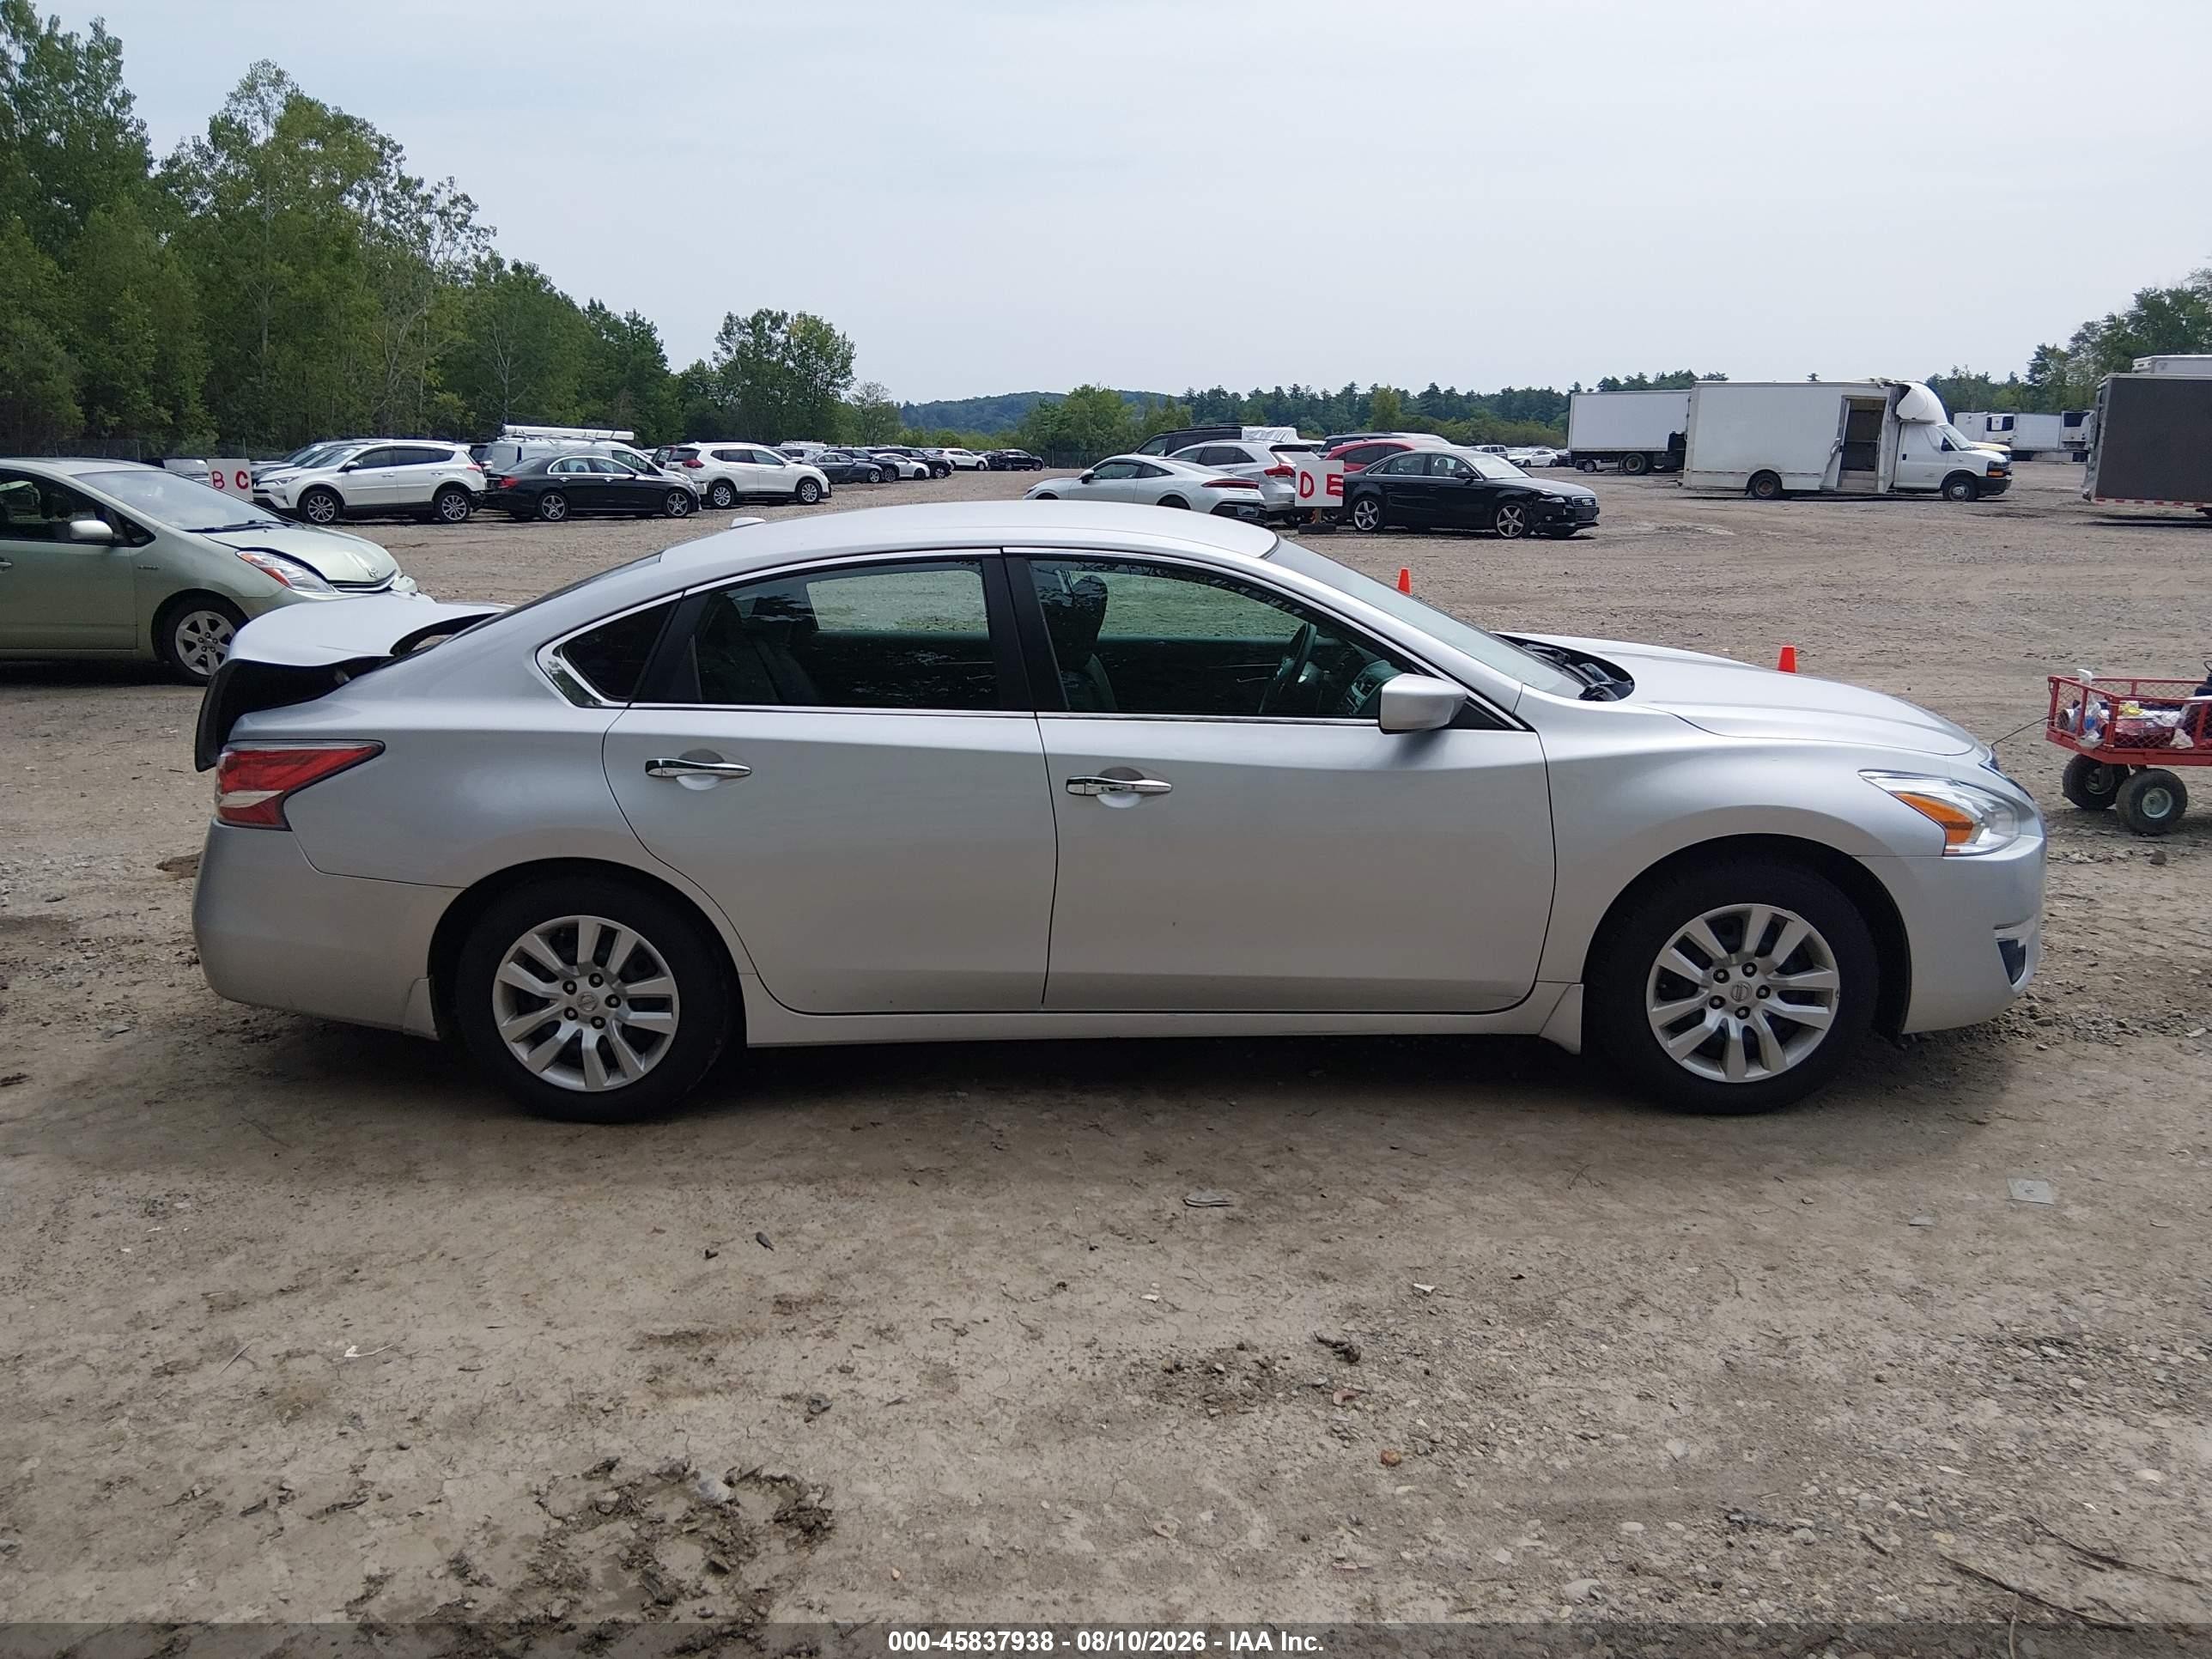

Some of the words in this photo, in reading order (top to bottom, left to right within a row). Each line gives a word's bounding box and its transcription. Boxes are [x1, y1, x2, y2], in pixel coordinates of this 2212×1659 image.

[211, 471, 225, 489] B
[235, 471, 249, 489] C
[1299, 471, 1315, 499] D
[1326, 473, 1344, 497] E
